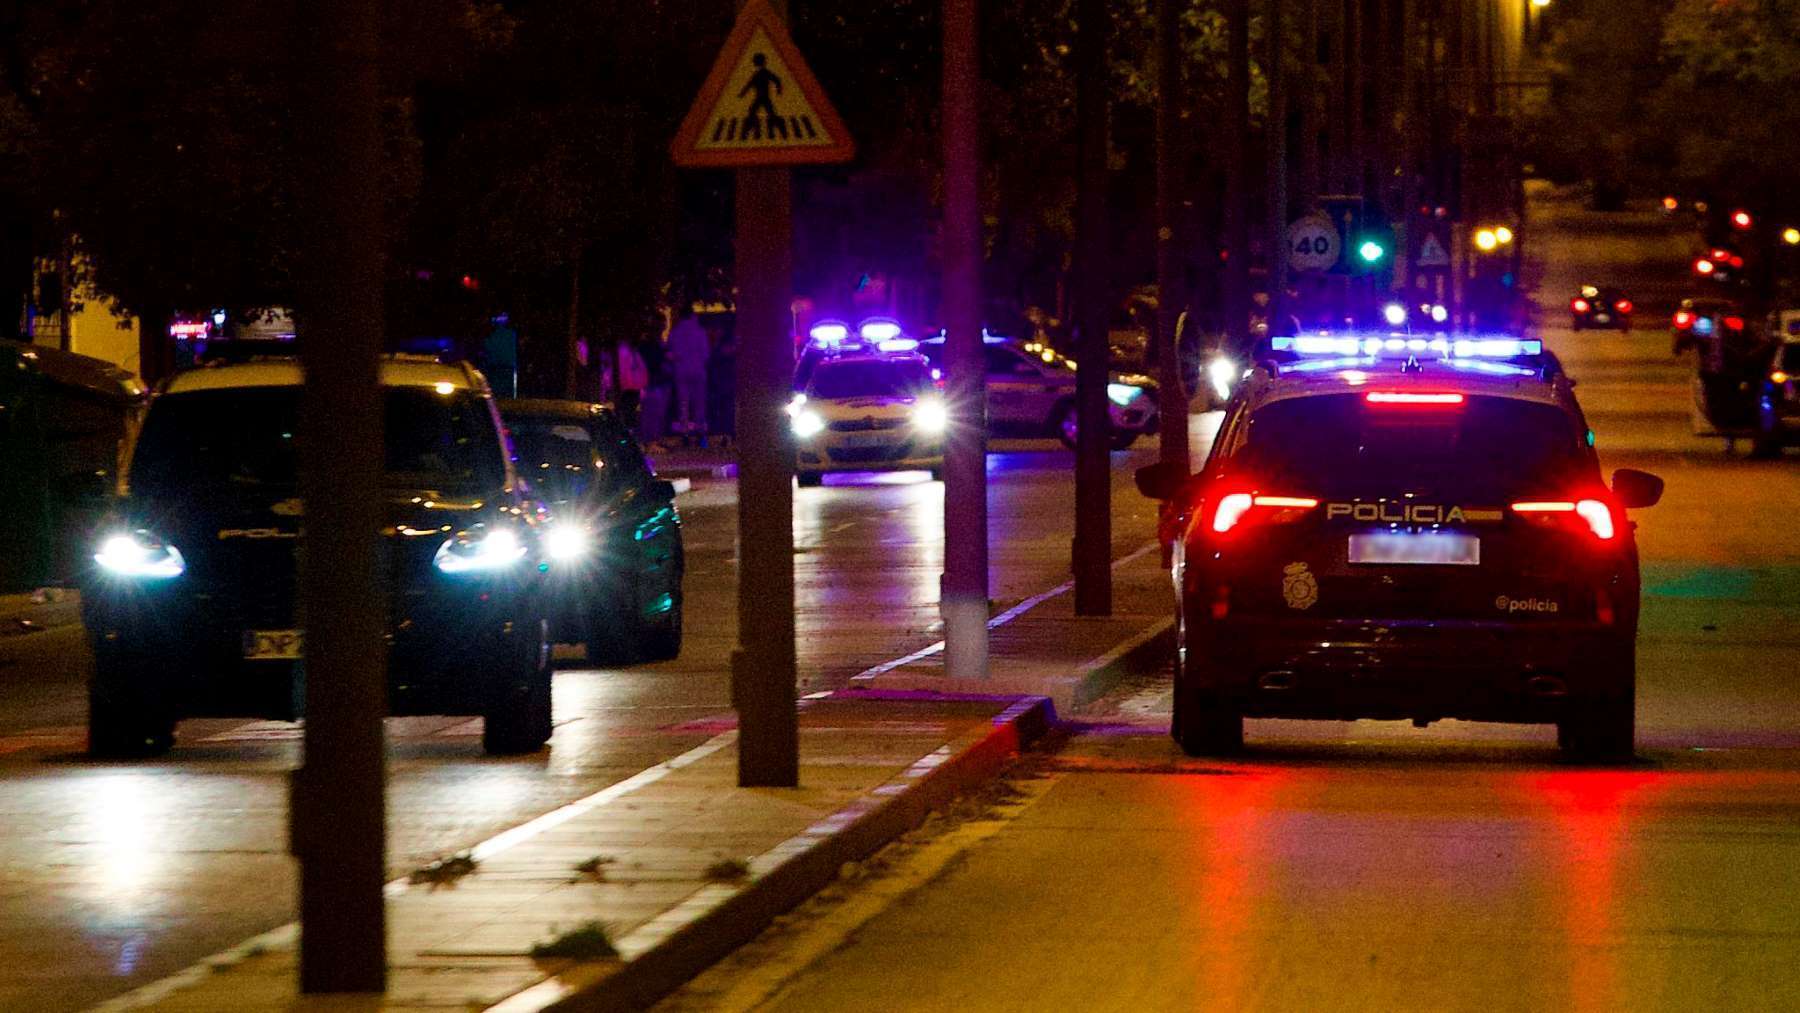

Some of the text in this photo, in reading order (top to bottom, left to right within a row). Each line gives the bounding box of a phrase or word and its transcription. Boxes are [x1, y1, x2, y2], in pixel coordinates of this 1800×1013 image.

[1295, 236, 1329, 255] 40
[1326, 503, 1466, 523] POLICIA
[1495, 595, 1559, 614] @policia
